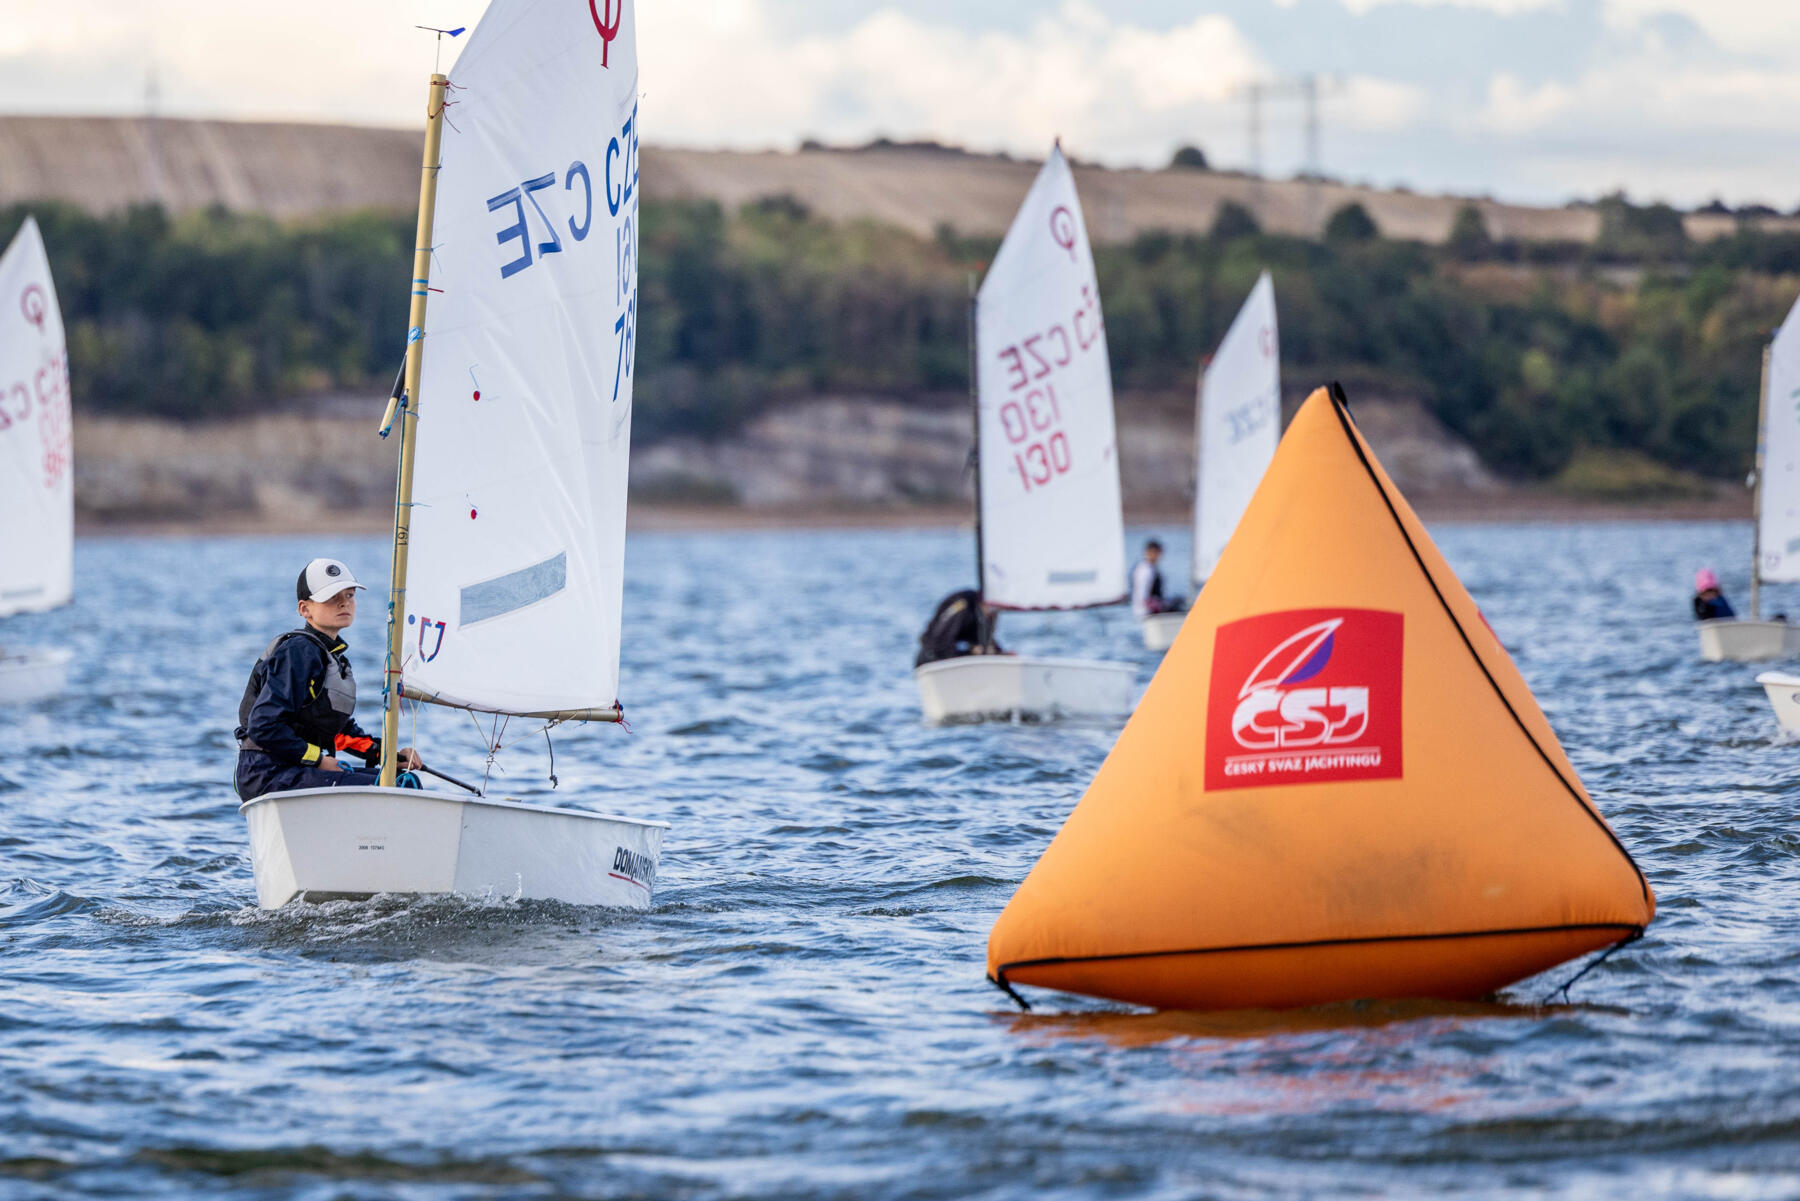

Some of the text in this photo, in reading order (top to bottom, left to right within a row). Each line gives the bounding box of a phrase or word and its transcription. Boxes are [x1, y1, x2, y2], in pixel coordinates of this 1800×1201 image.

[606, 97, 639, 217] CZE
[1014, 430, 1071, 493] 130
[1267, 757, 1301, 773] SVAZ
